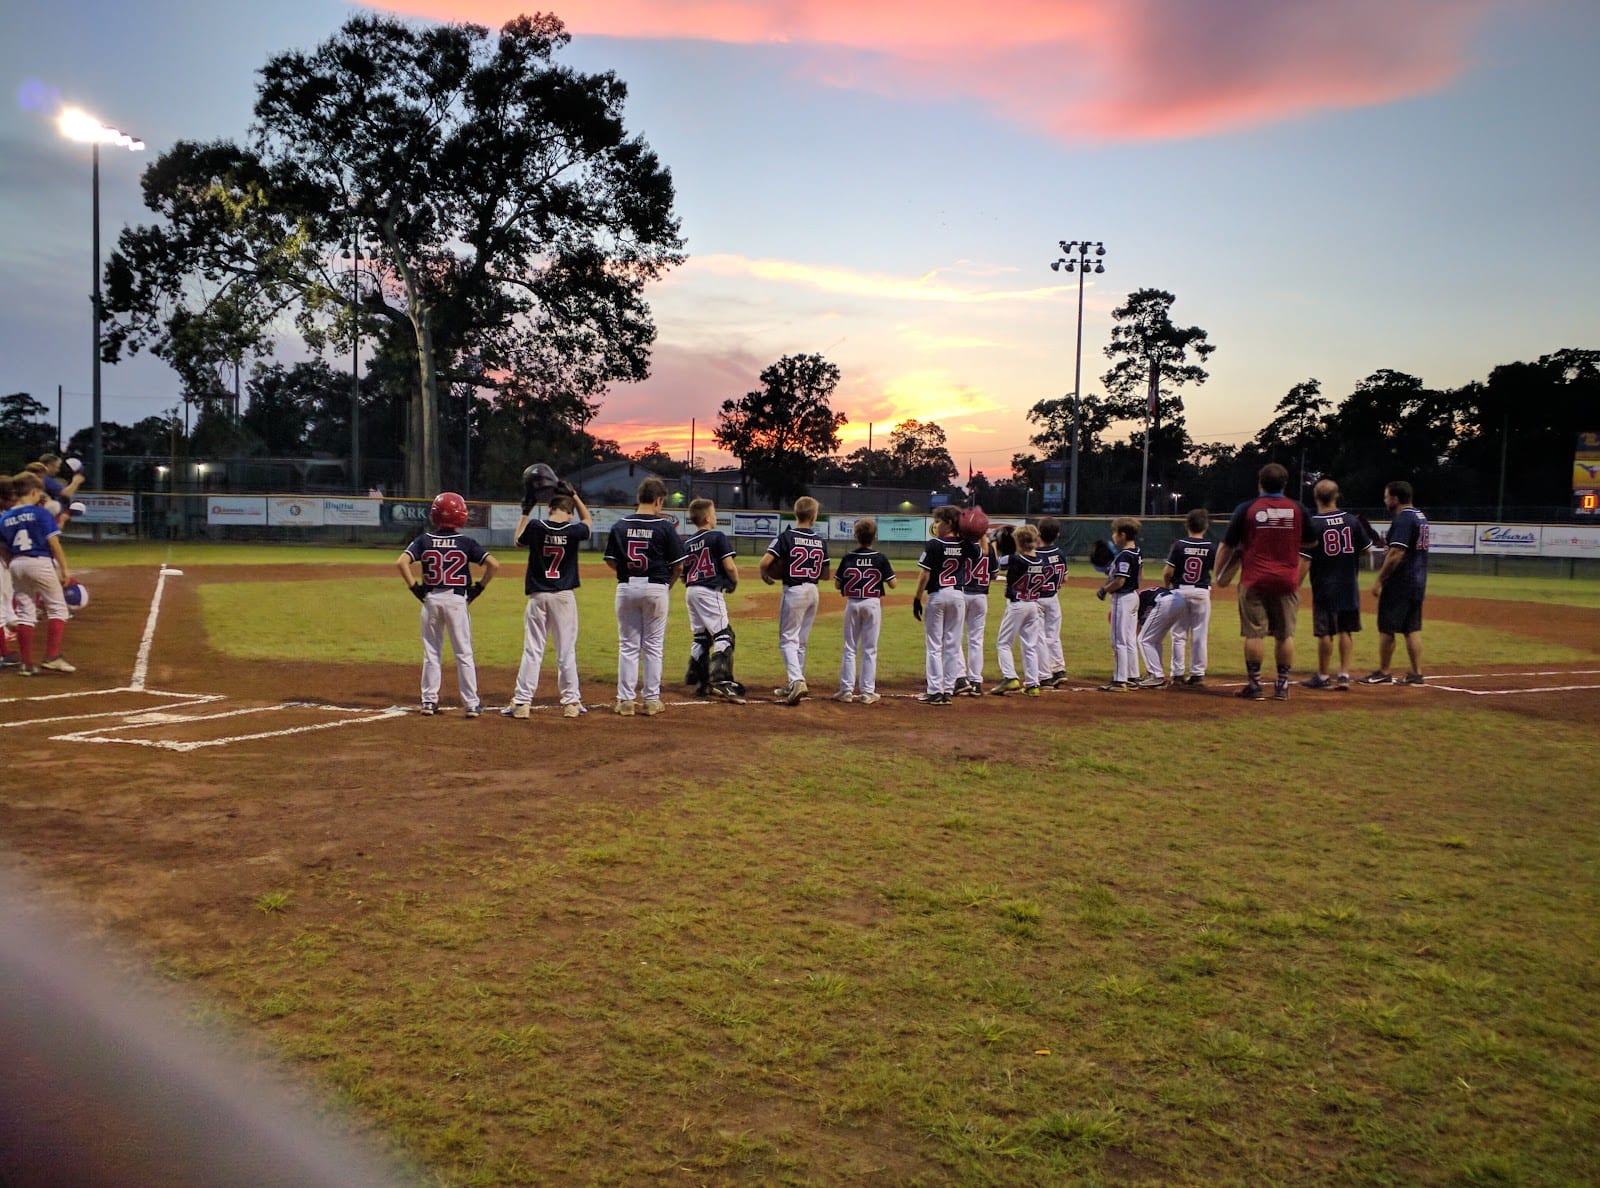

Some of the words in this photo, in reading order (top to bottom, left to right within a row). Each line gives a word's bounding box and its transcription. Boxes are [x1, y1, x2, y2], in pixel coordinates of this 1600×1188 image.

[13, 529, 33, 551] 4
[432, 538, 457, 548] TEALL
[1323, 526, 1354, 556] 81
[421, 549, 467, 586] 32
[543, 545, 566, 579] 7
[627, 540, 649, 572] 5
[684, 547, 717, 583] 24
[789, 546, 825, 579] 23
[1183, 556, 1203, 584] 9
[843, 567, 882, 599] 22
[939, 558, 959, 586] 2
[1012, 573, 1045, 600] 42
